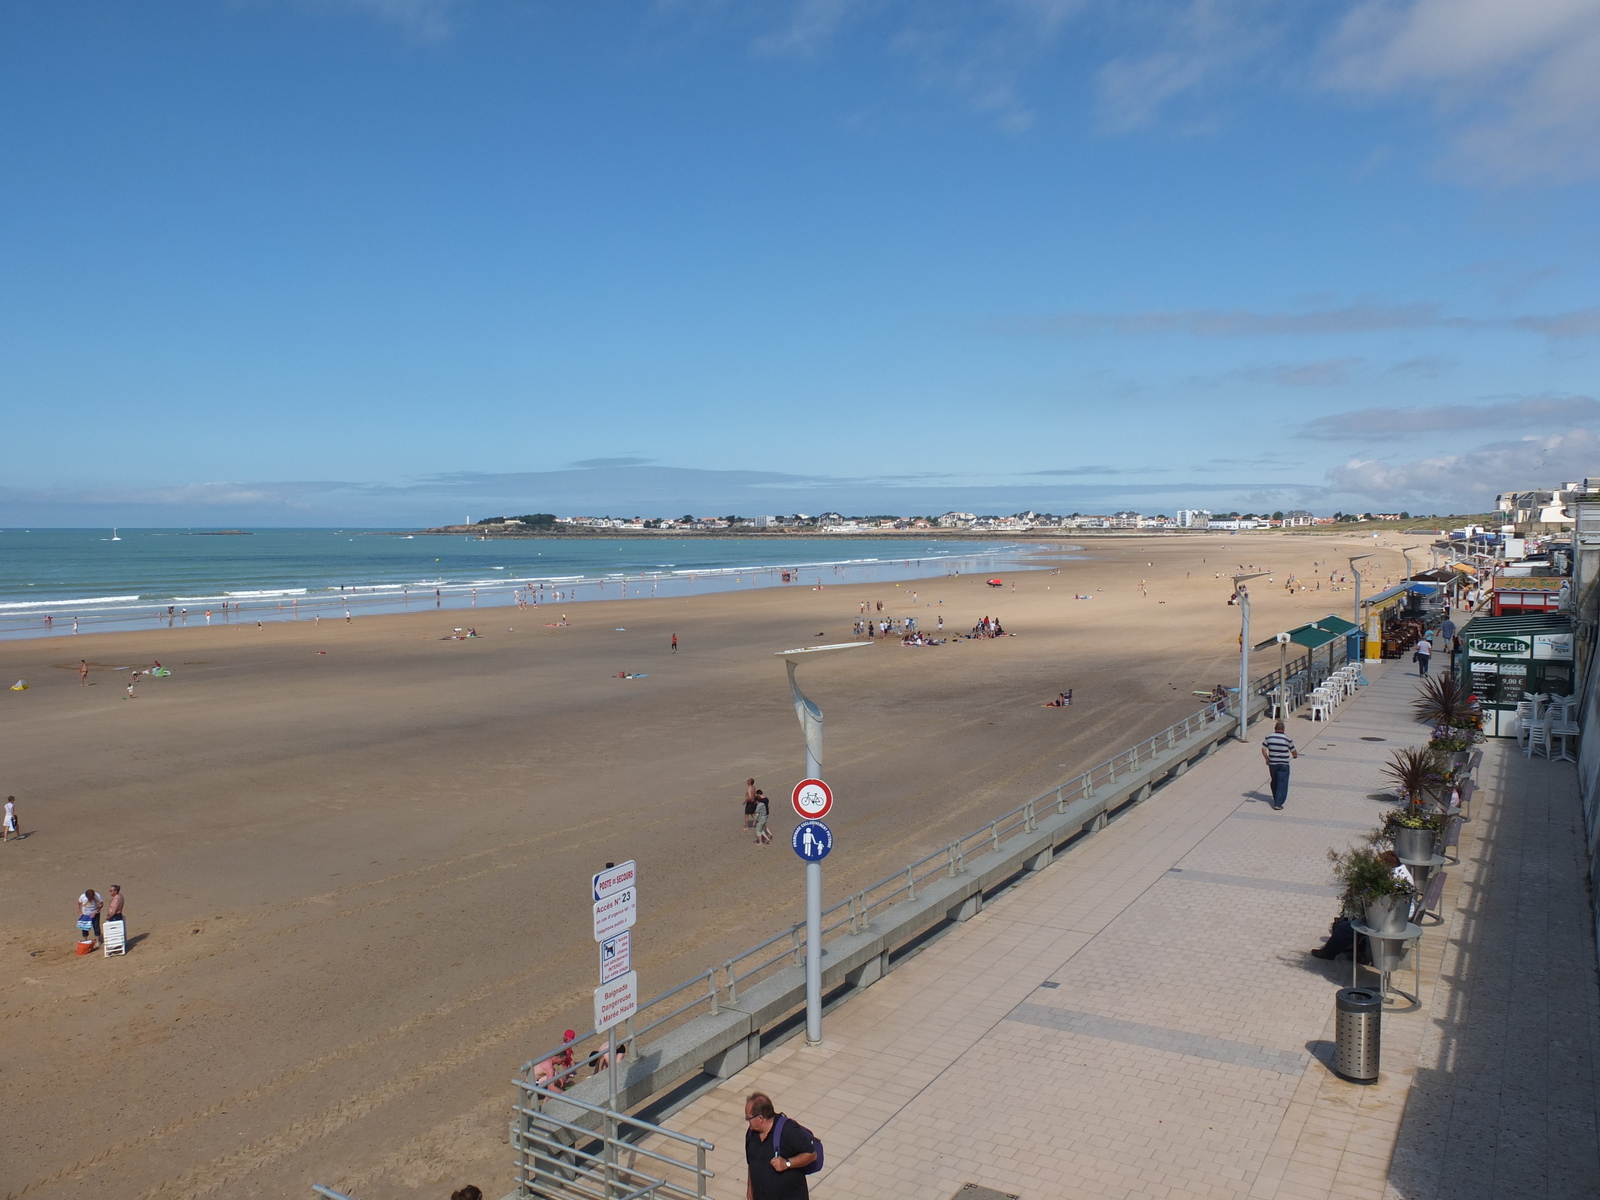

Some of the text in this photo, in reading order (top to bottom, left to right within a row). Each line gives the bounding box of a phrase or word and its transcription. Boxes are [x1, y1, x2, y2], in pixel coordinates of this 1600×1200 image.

[1474, 639, 1526, 651] Pizzeria
[1518, 678, 1524, 686] €
[599, 878, 612, 891] POSTE
[617, 870, 634, 884] SECOURS
[622, 891, 631, 903] 23
[604, 984, 628, 1000] Baignade
[601, 993, 631, 1013] Dangereuse
[603, 1010, 619, 1023] Marée
[619, 1002, 634, 1014] Haute
